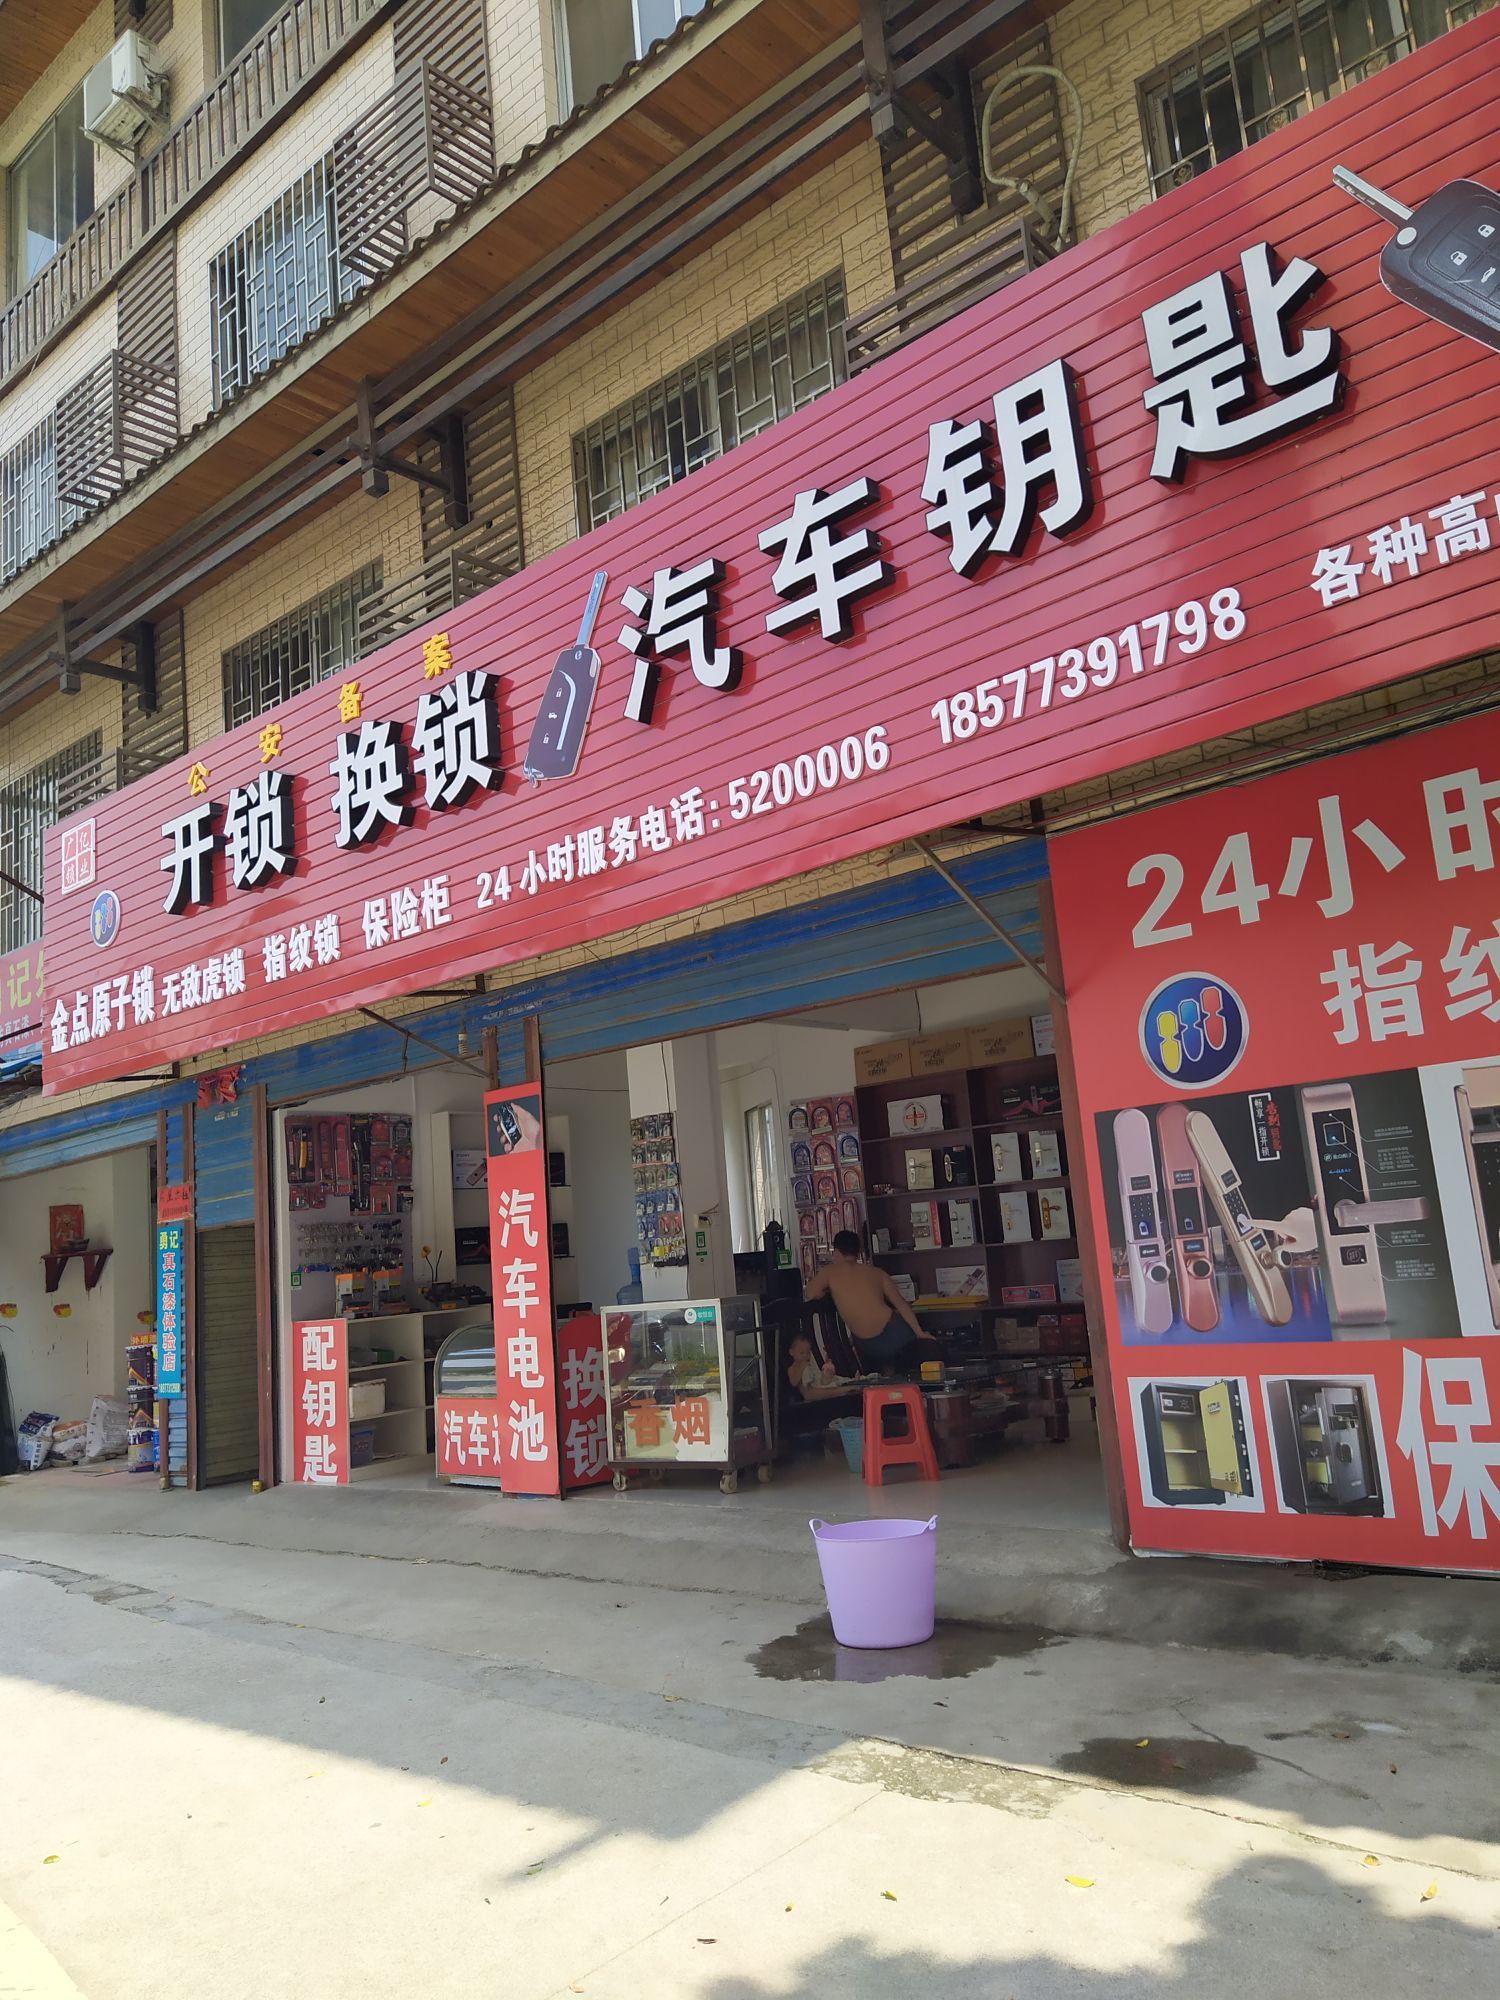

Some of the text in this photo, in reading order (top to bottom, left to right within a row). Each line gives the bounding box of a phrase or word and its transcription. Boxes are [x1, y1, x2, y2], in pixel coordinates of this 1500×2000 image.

[161, 241, 1342, 914] 开锁 换锁 汽车钥匙
[51, 965, 155, 1054] 金点原子锁
[161, 949, 247, 1017] 无敌虎锁
[263, 914, 341, 982] 指纹锁
[362, 874, 452, 950] 保险柜
[931, 587, 1246, 743] 18577391798
[1311, 491, 1500, 607] 各种高
[187, 633, 452, 796] 公安备案
[162, 1252, 177, 1372] 真石漆体验店
[498, 1189, 549, 1462] 汽车电池
[301, 1326, 338, 1484] 配钥匙
[627, 1395, 711, 1447] 香烟
[1396, 1347, 1500, 1540] 保
